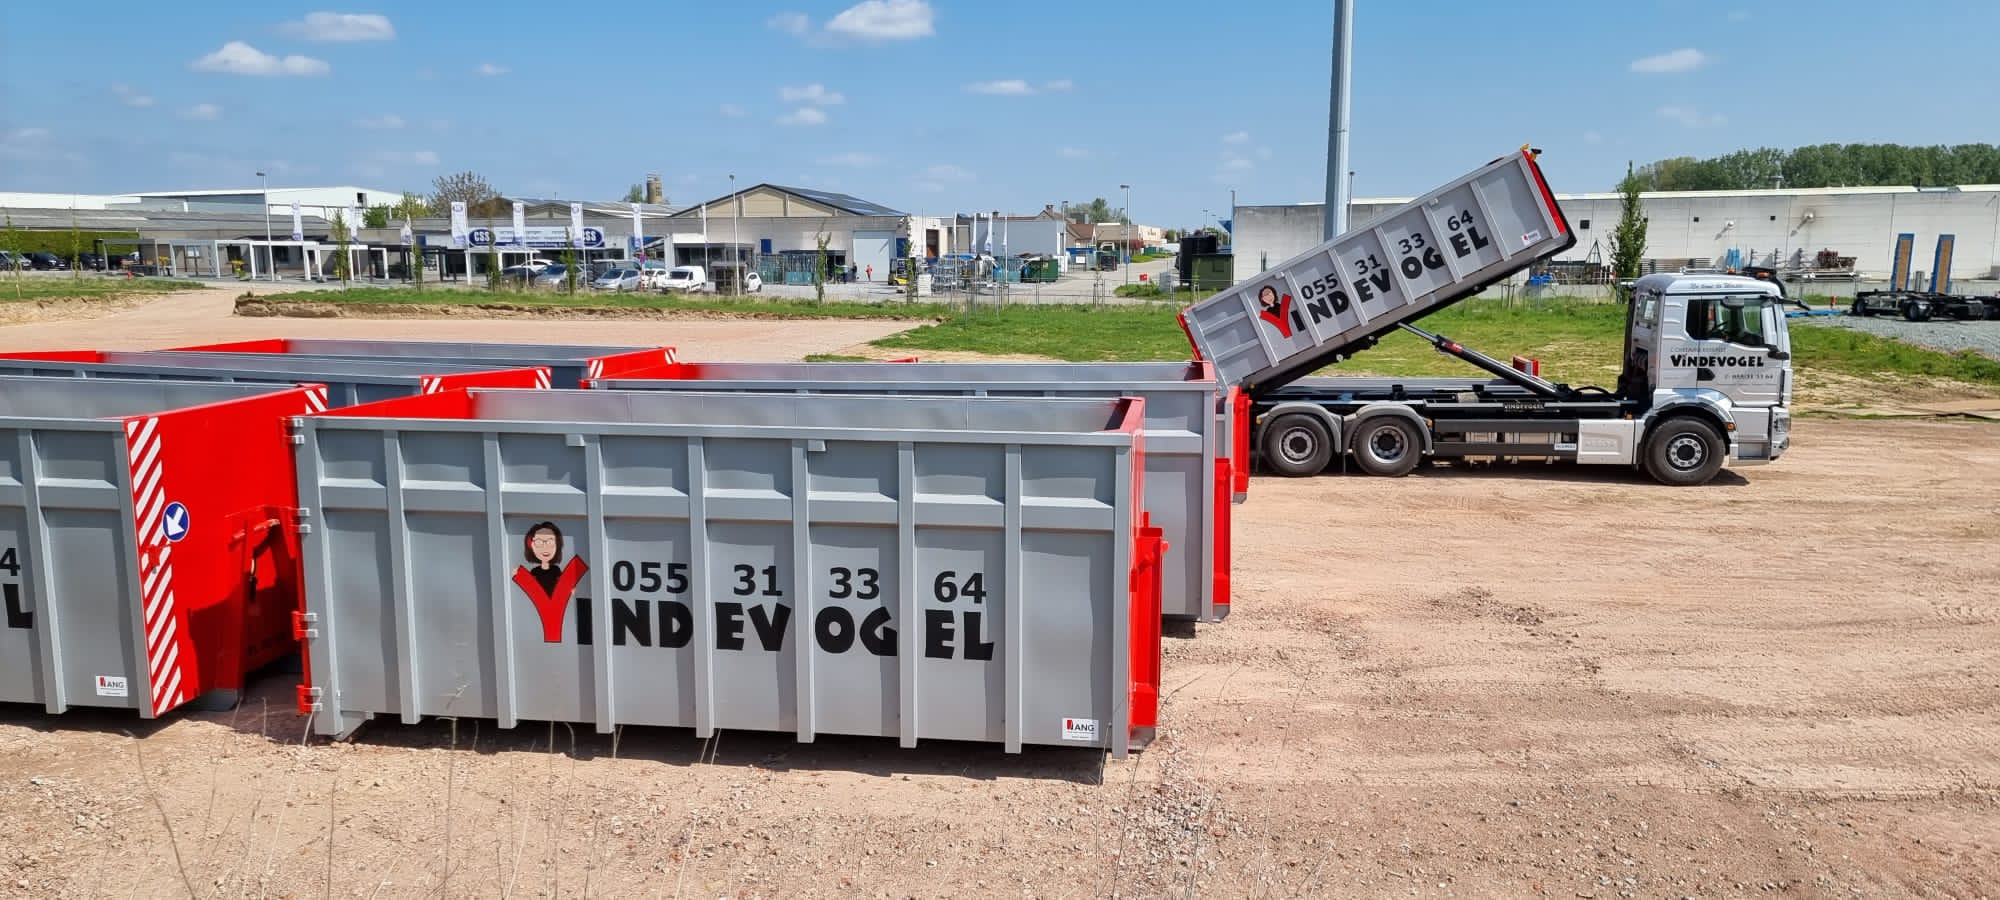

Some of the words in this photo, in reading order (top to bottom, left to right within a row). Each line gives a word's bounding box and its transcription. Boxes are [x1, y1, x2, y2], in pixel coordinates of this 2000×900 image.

[474, 231, 490, 242] CSS
[1301, 273, 1339, 301] 055
[1354, 254, 1382, 276] 31
[1399, 232, 1426, 255] 33
[1447, 209, 1474, 232] 64
[611, 560, 689, 594] 055
[733, 563, 784, 597] 31
[828, 567, 881, 600] 33
[933, 571, 987, 604] 64
